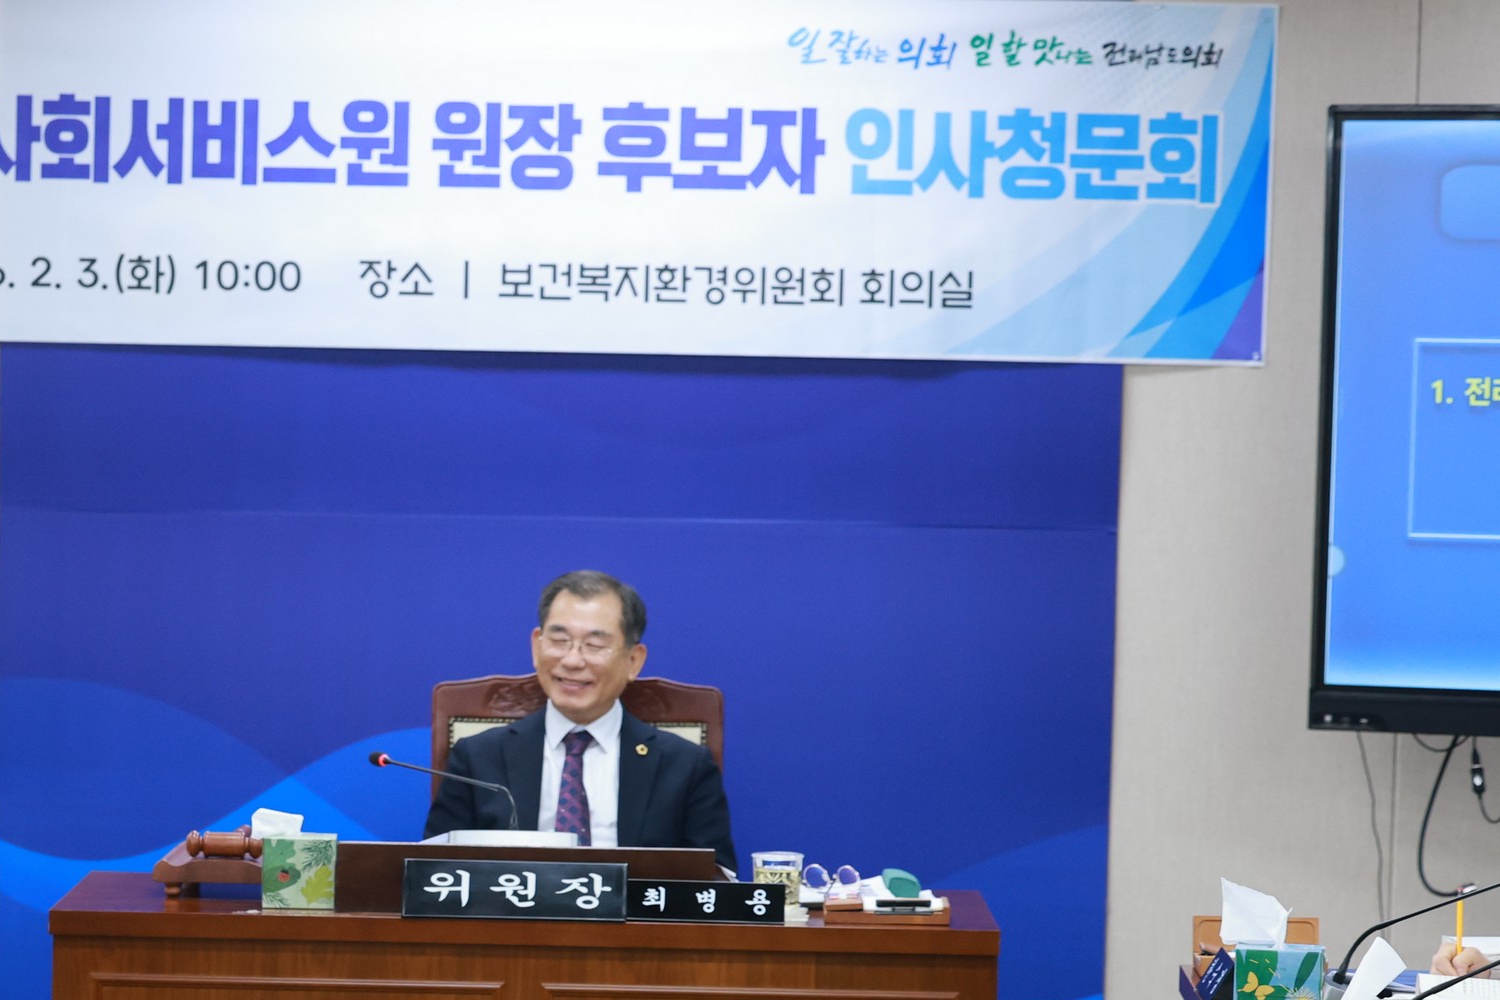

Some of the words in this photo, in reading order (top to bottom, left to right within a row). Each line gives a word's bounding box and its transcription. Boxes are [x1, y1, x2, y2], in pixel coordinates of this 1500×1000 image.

[897, 33, 959, 71] 의회
[432, 101, 583, 192] 원장
[598, 102, 826, 196] 후보자
[845, 107, 1221, 204] 인사청문회
[31, 257, 63, 291] 2.
[195, 261, 303, 294] 10:00
[360, 261, 435, 301] 장소
[498, 263, 846, 308] 보건복지환경위원회
[859, 269, 975, 311] 회의실
[1431, 379, 1454, 405] 1.
[423, 869, 613, 911] 위원장
[641, 886, 772, 917] 최병용
